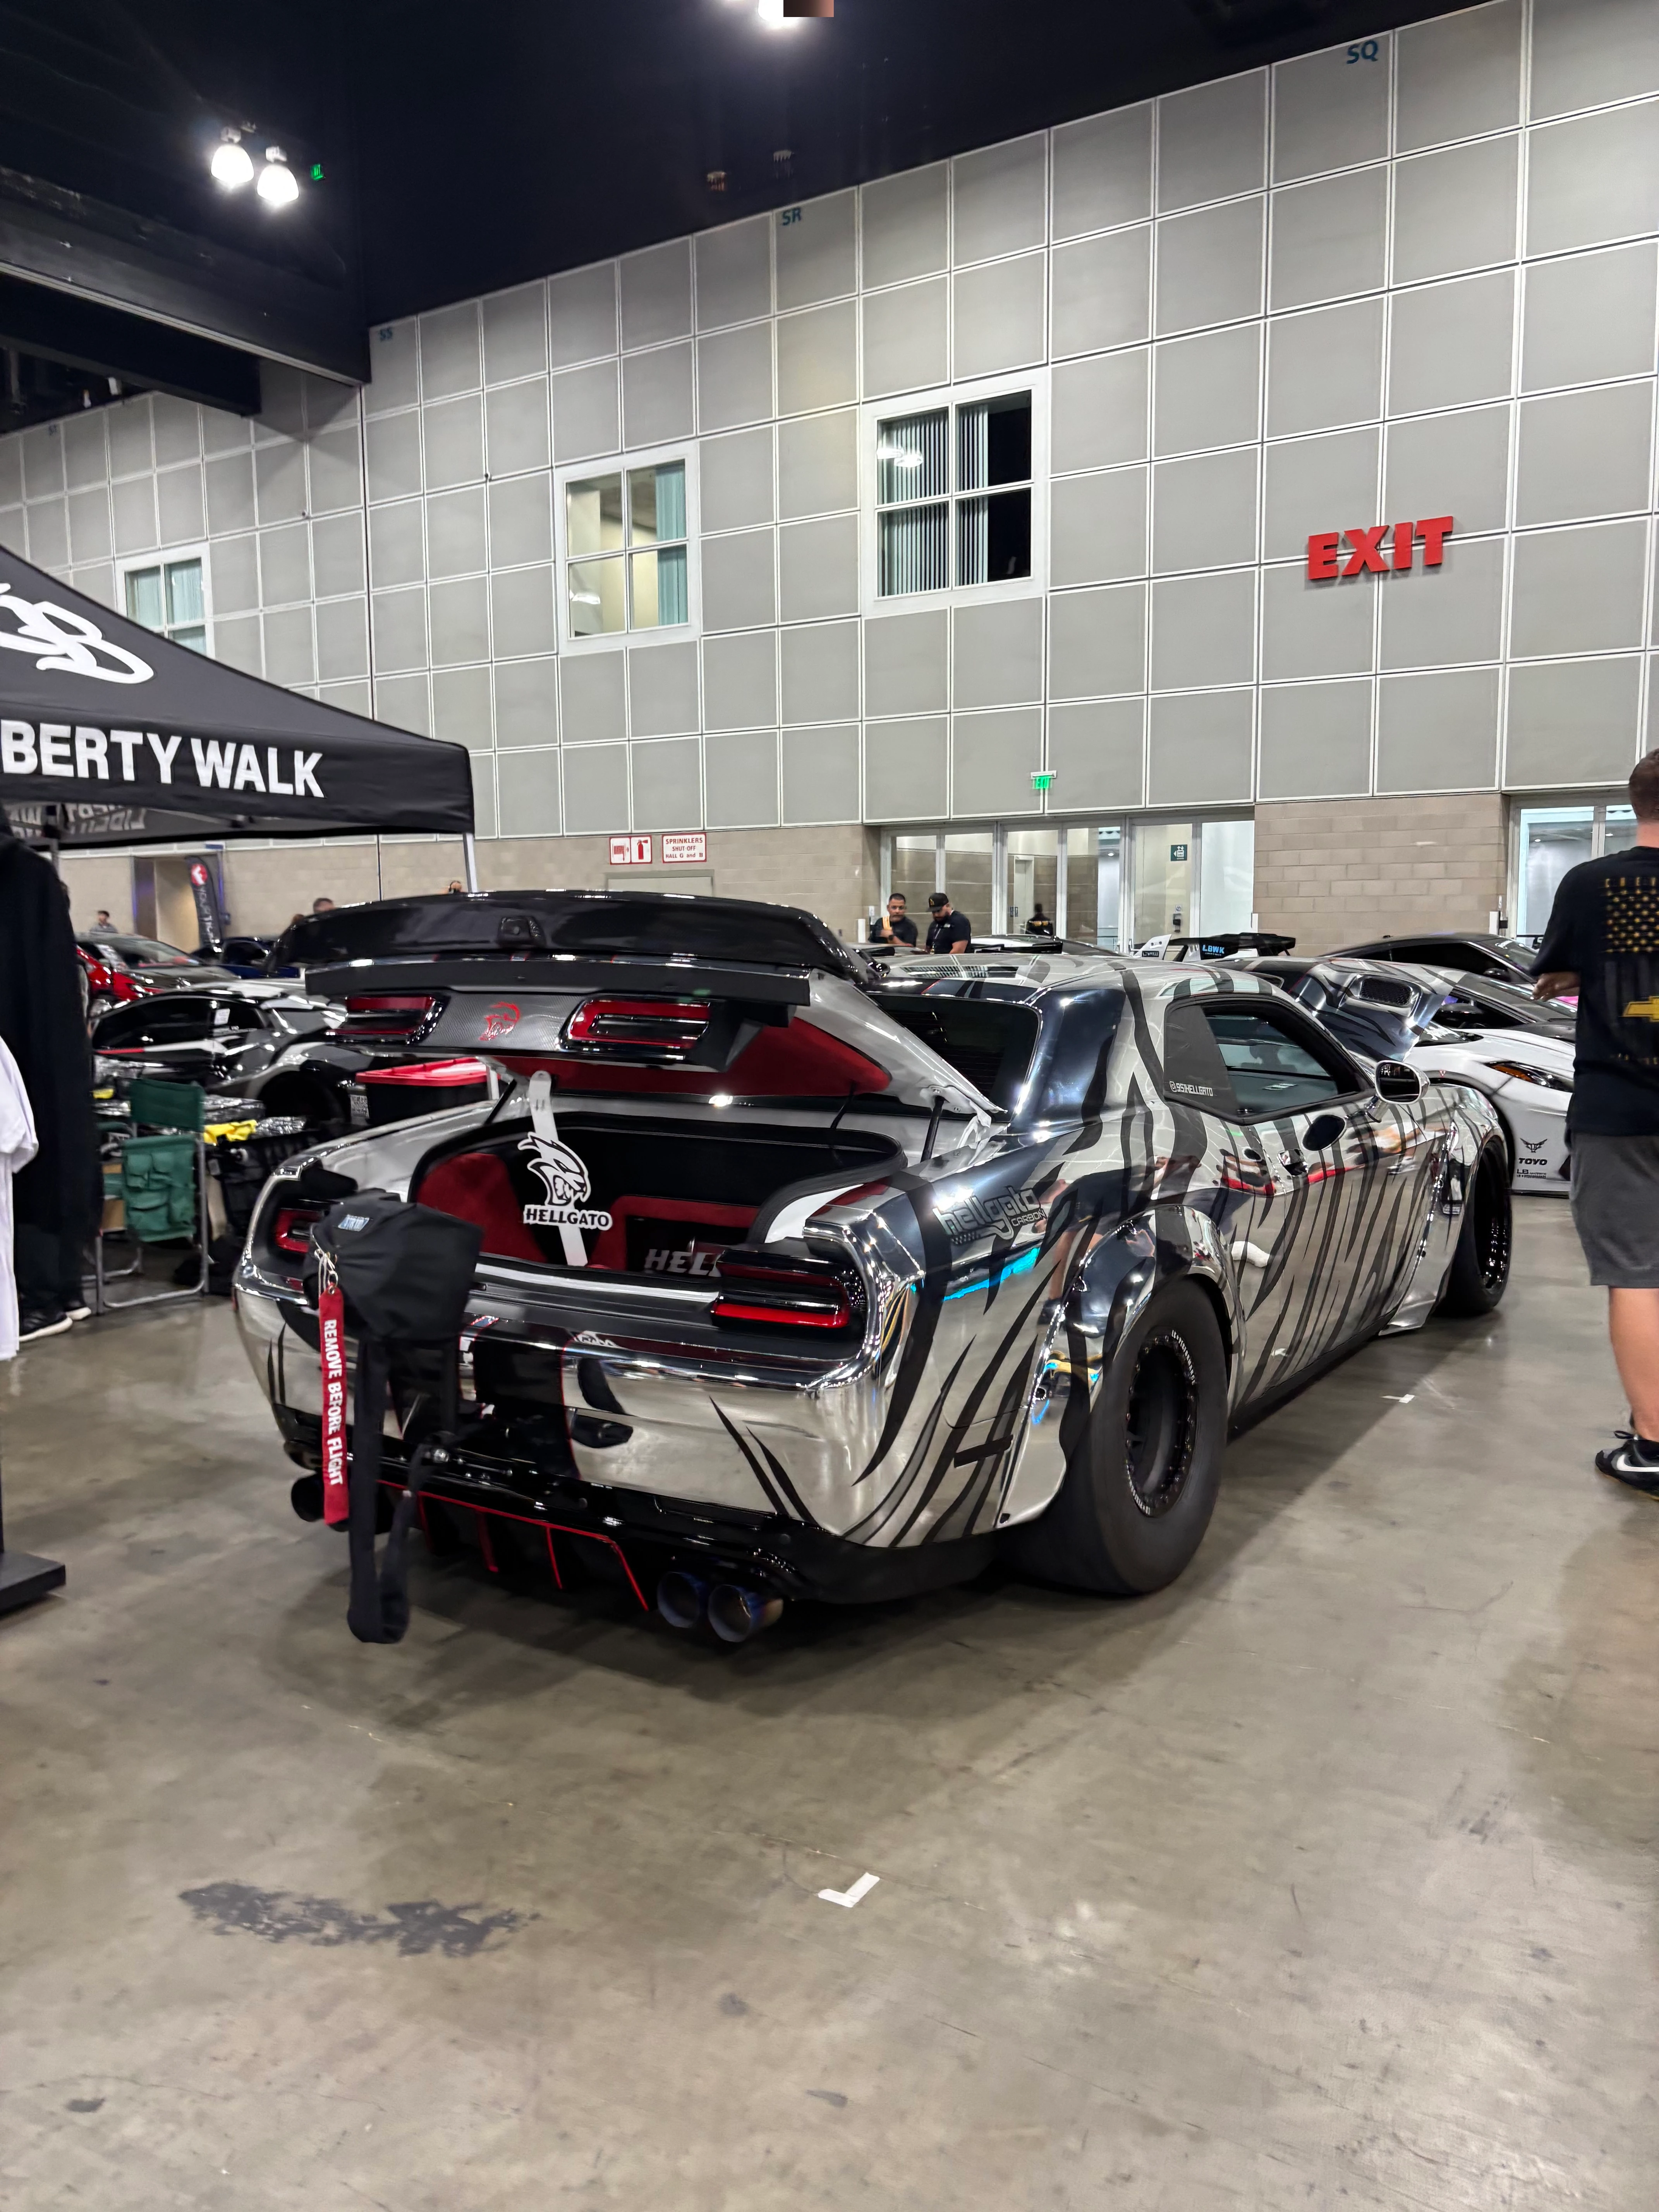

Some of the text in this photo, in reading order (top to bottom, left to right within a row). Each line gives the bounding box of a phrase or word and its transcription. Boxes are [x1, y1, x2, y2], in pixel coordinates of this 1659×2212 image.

[1346, 40, 1378, 64] SQ
[782, 208, 801, 226] SR
[1308, 515, 1454, 580] EXIT
[191, 737, 327, 798] WALK
[1202, 945, 1225, 954] LBWK
[526, 1208, 609, 1227] HELLGATO
[1011, 1209, 1046, 1227] CARBON
[324, 1319, 343, 1486] REMOVE BEFORE FLIGHT
